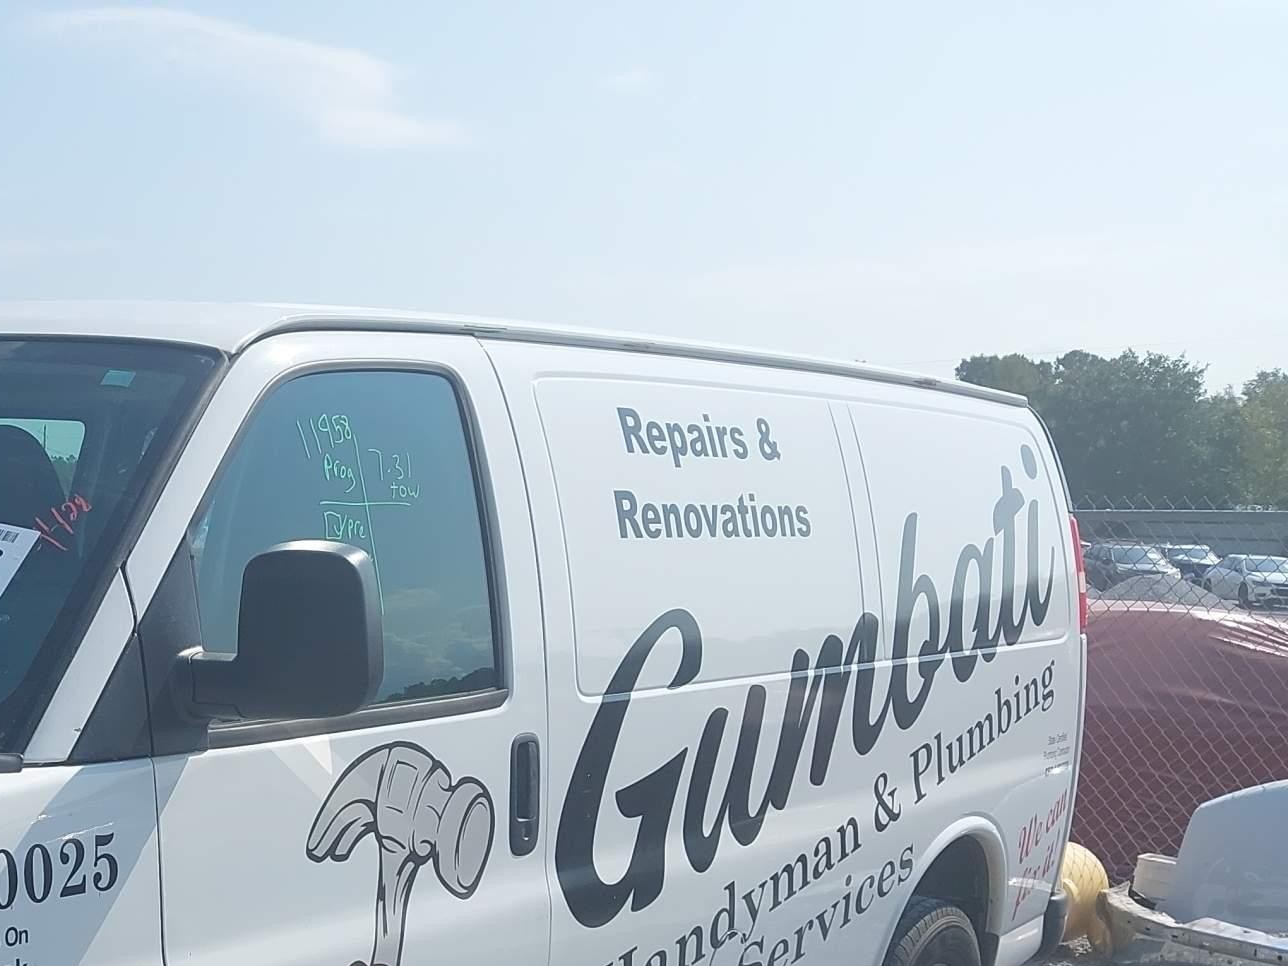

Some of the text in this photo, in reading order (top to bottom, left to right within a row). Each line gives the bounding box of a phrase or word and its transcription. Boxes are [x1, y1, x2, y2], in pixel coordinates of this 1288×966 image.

[616, 406, 782, 468] Repairs &
[389, 481, 420, 500] tow
[613, 489, 812, 539] Renovations
[555, 444, 1056, 929] Gumbati
[873, 771, 902, 833] &
[909, 659, 1056, 805] Plumbing
[1018, 812, 1042, 865] We
[1045, 787, 1068, 834] can
[5, 926, 29, 947] On
